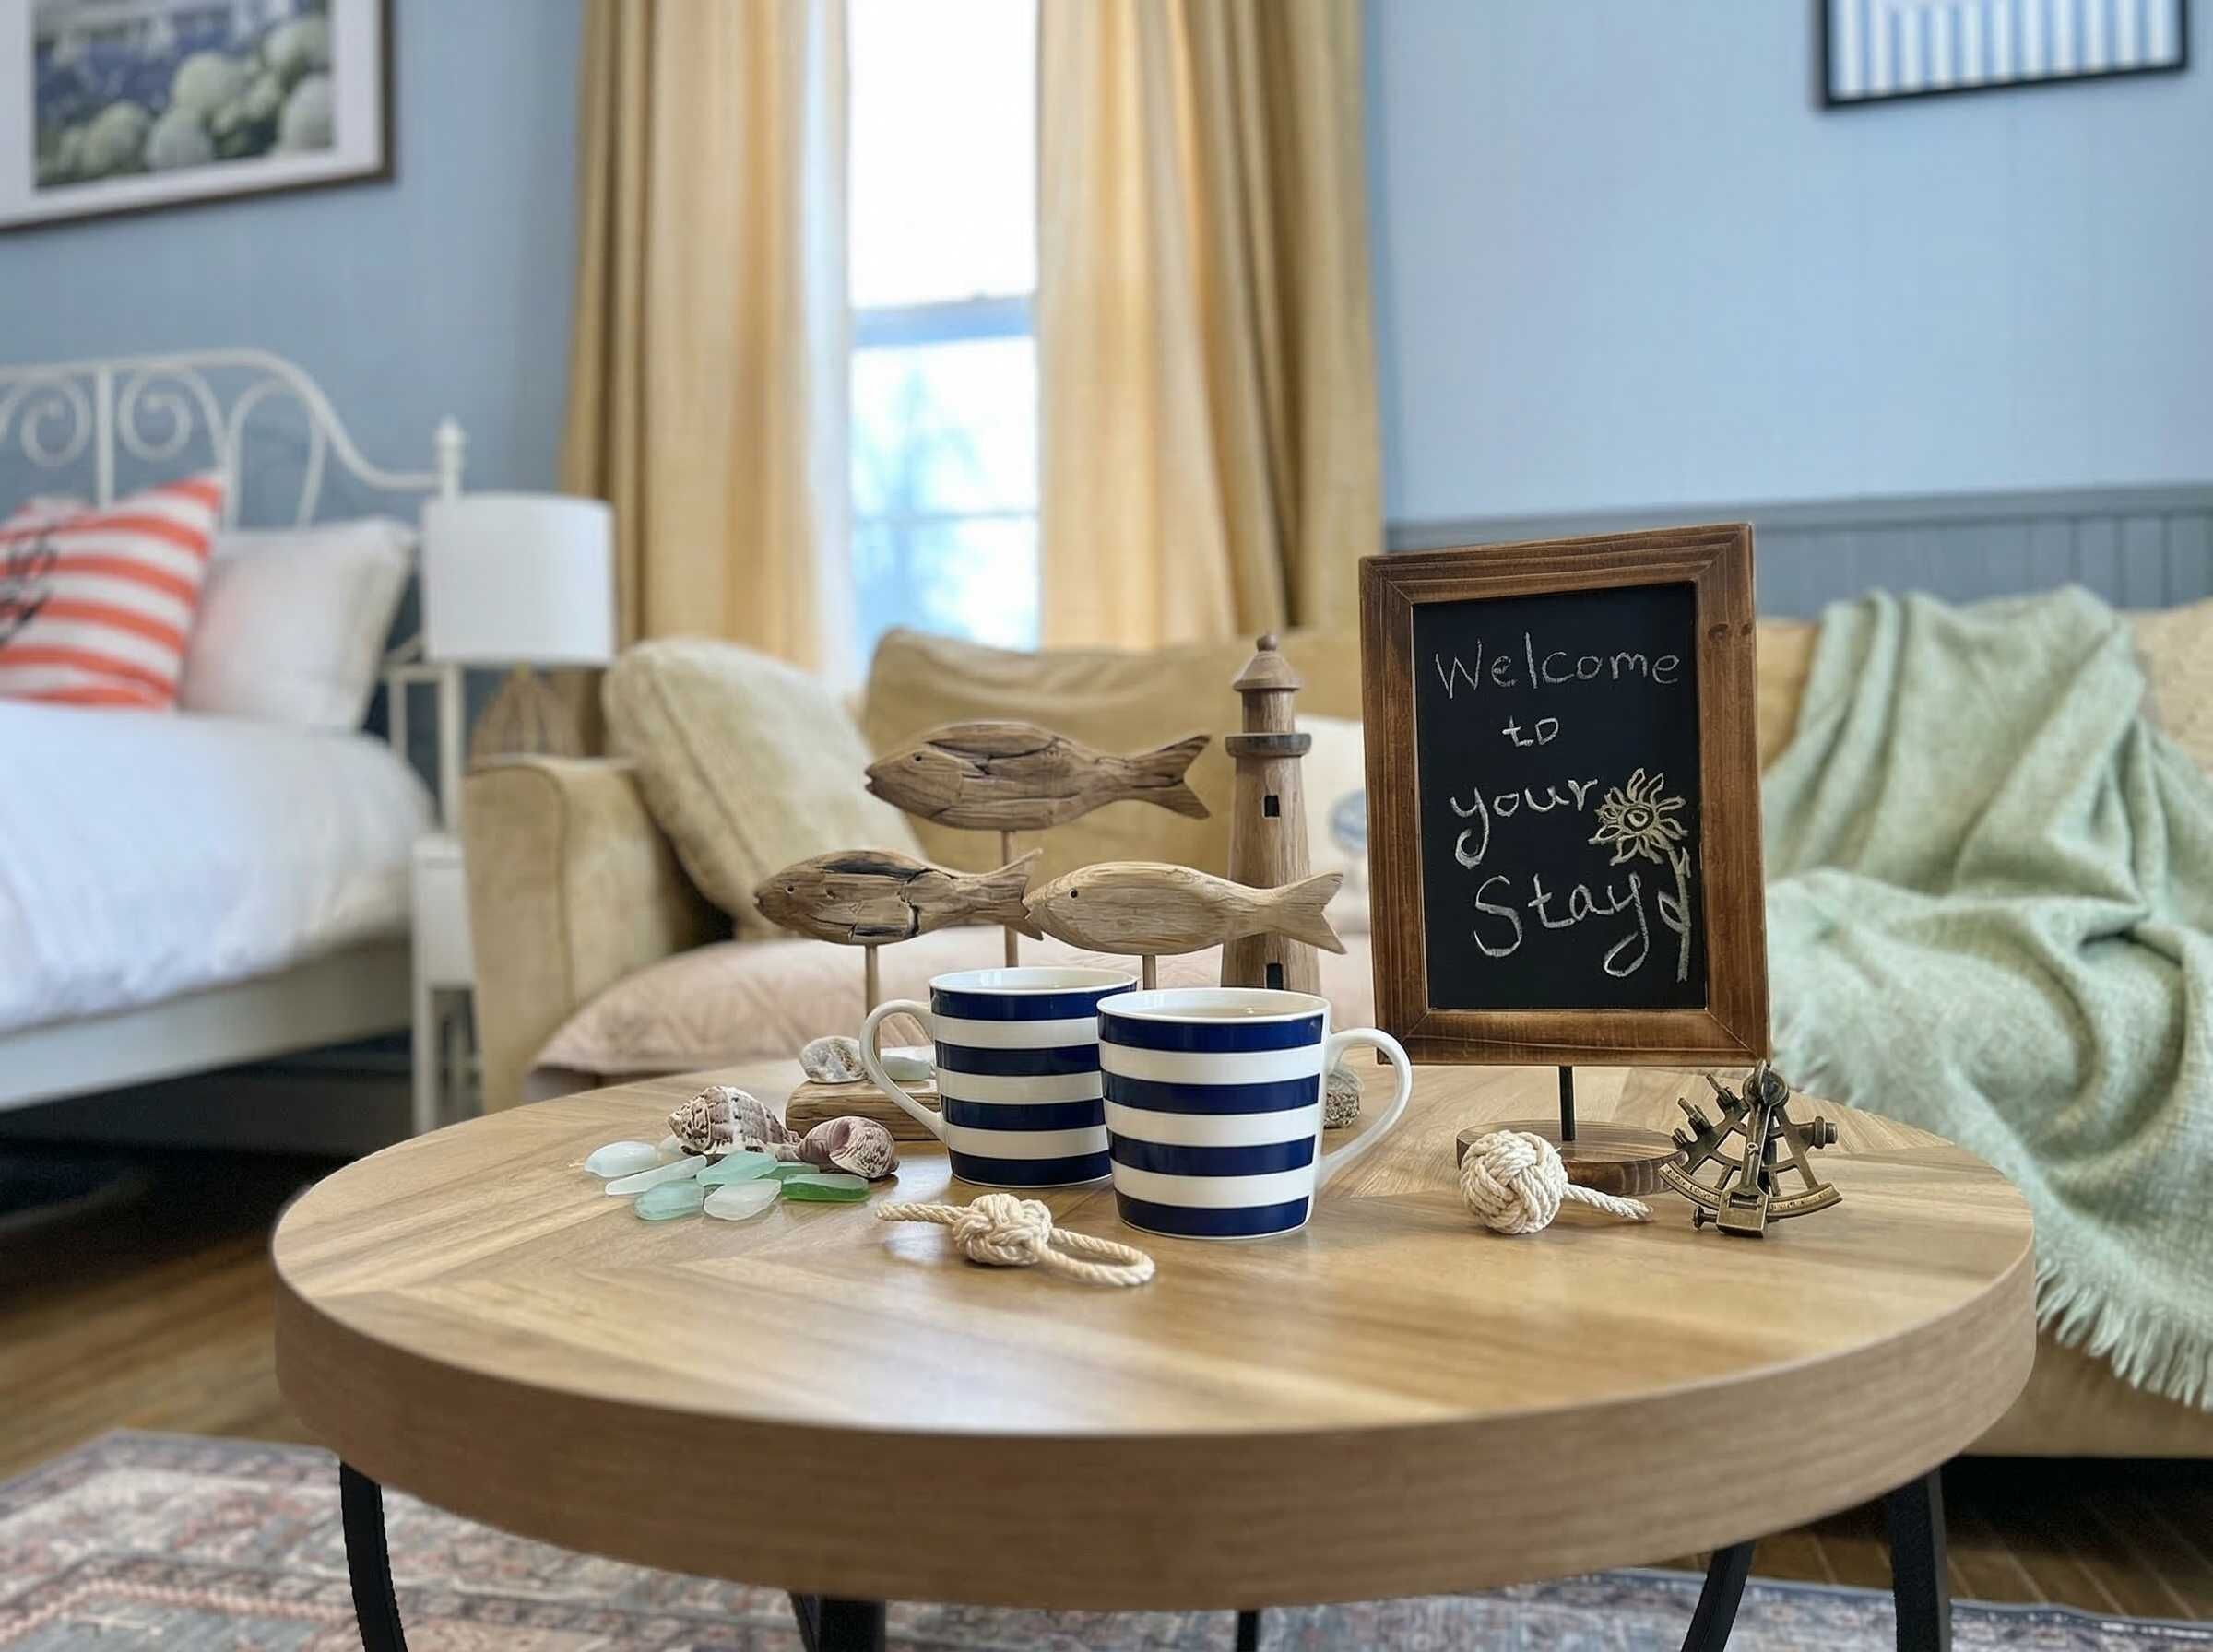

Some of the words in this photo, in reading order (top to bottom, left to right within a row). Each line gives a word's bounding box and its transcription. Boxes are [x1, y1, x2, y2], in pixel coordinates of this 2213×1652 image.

[1436, 632, 1680, 699] Welcome
[1503, 716, 1559, 747] to
[1450, 779, 1598, 869] your
[1474, 872, 1649, 977] Stay
